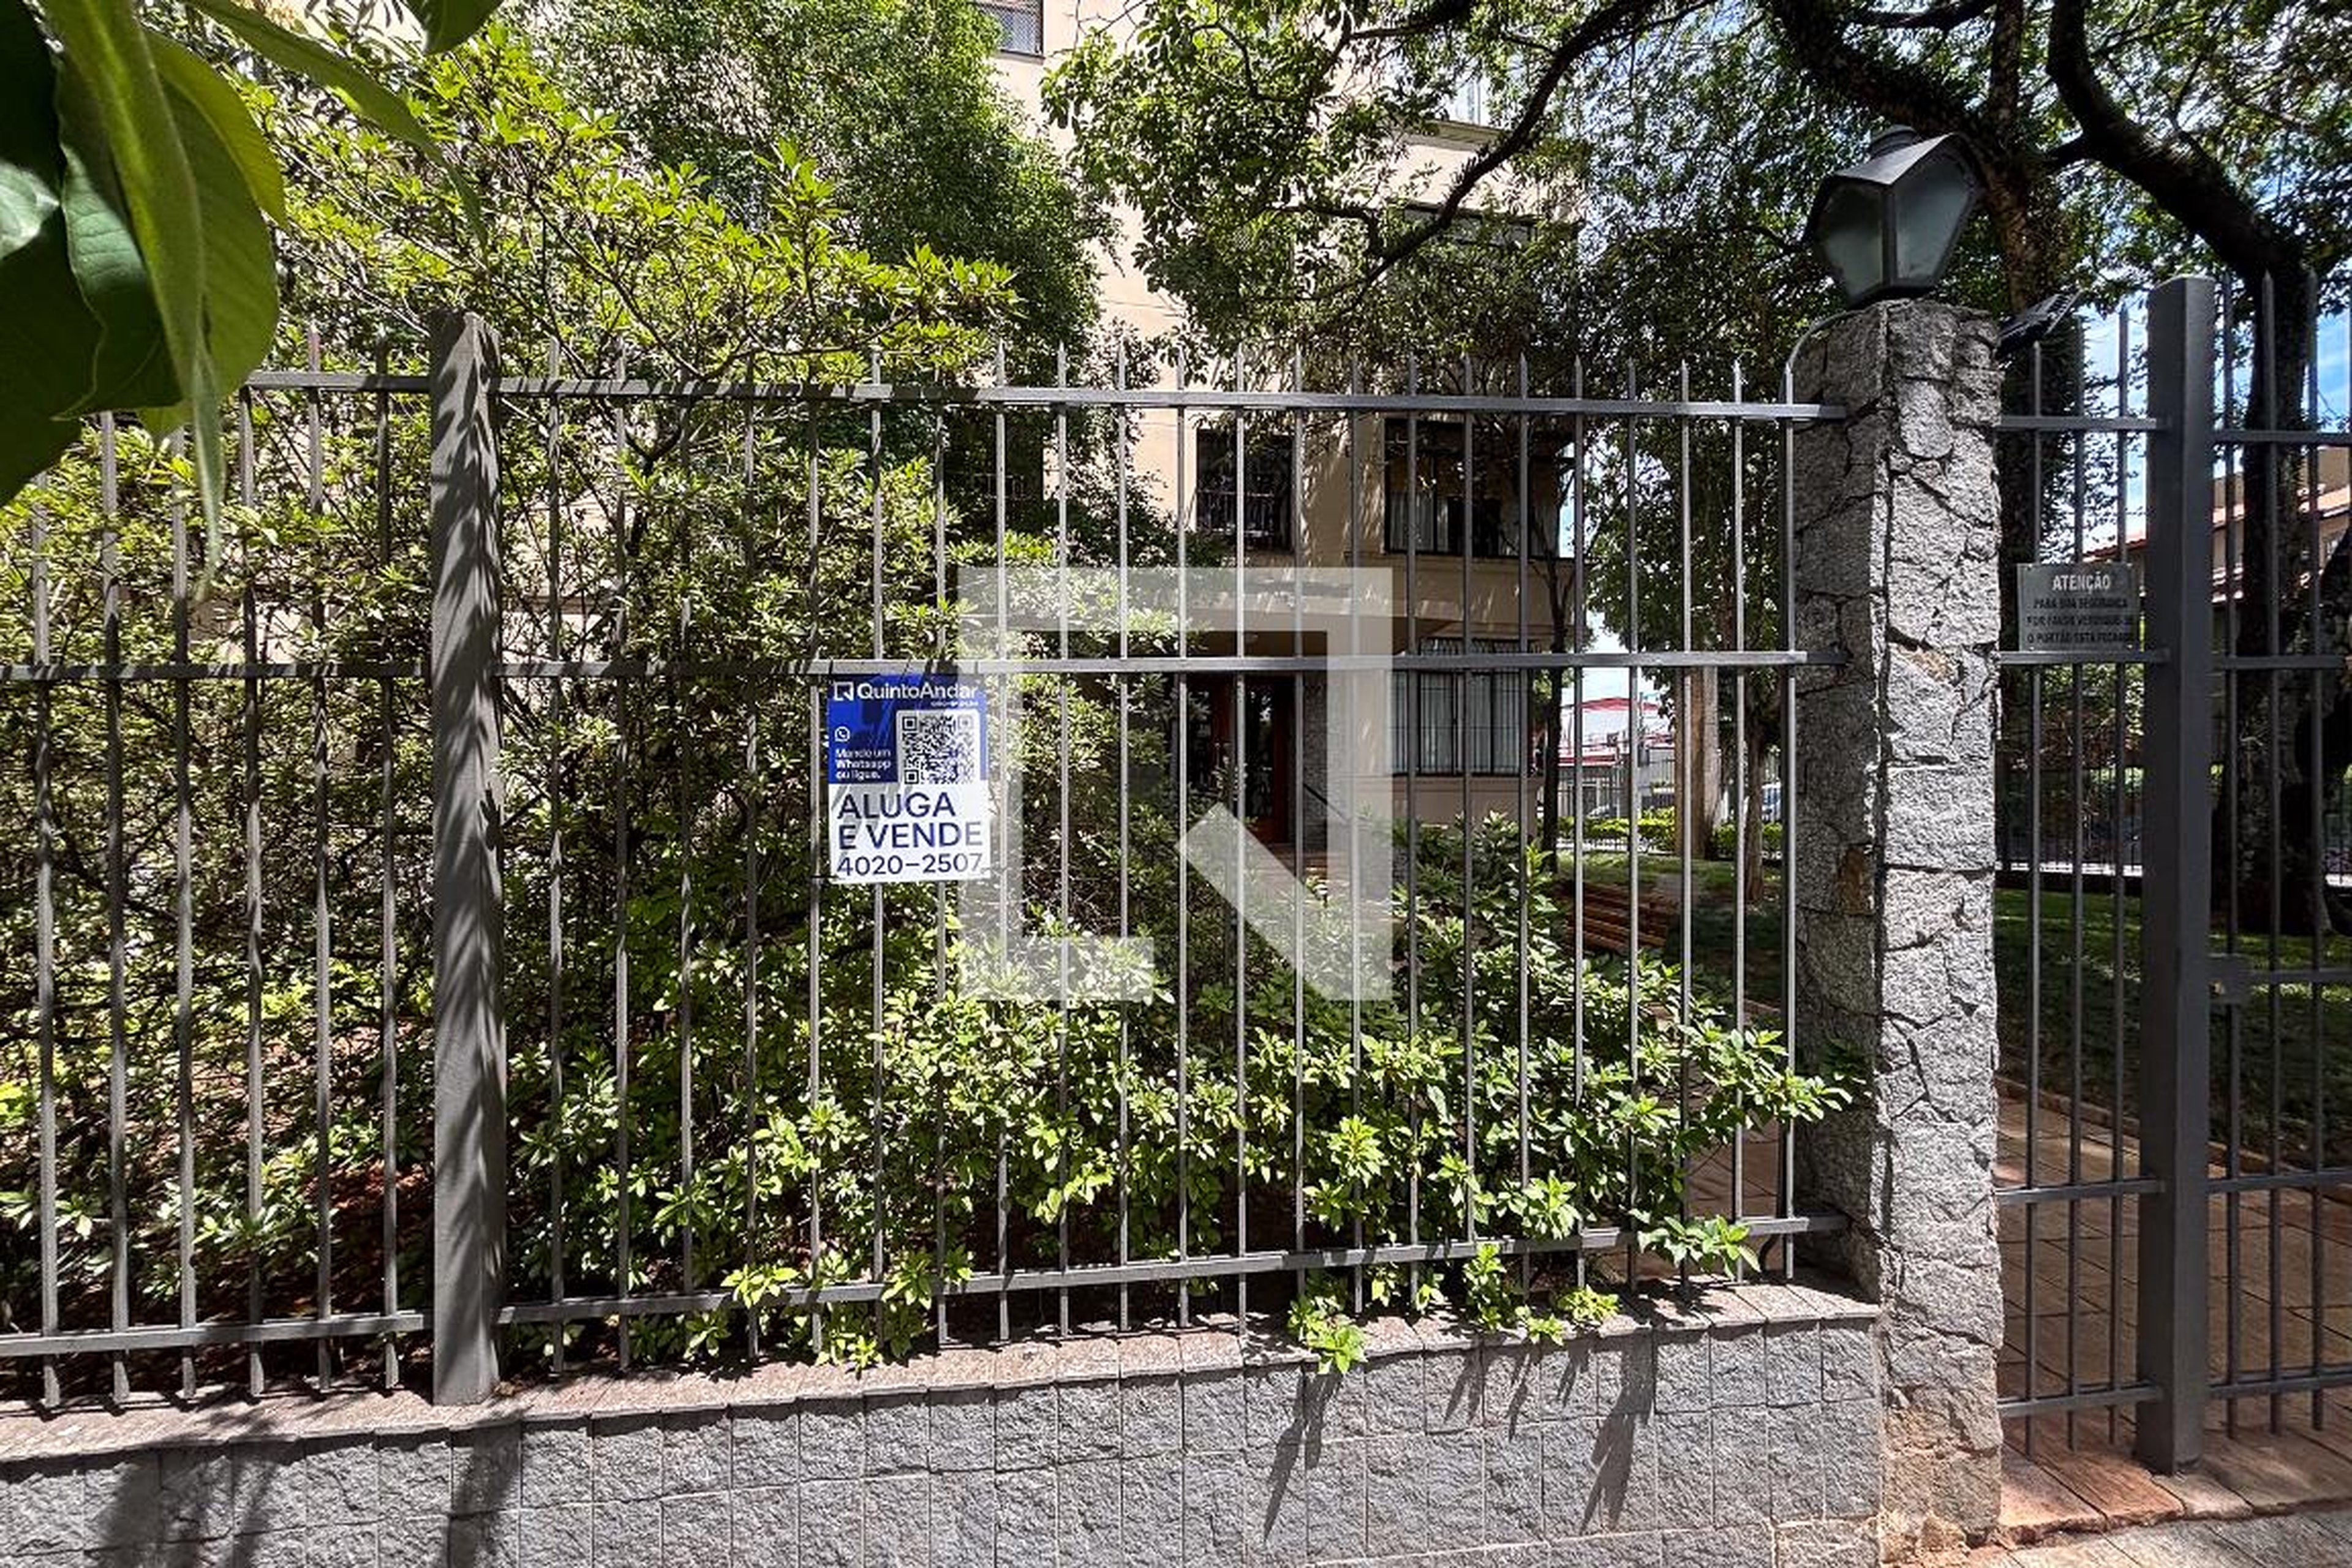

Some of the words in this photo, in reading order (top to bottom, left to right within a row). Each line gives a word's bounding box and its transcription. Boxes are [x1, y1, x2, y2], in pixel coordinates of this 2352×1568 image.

[2052, 571, 2111, 594] ATENÇÃO
[858, 682, 978, 699] QuintoAndar
[837, 792, 956, 819] ALUGA
[839, 825, 857, 850] E
[865, 821, 983, 848] VENDE
[837, 853, 982, 876] 4020-2507
